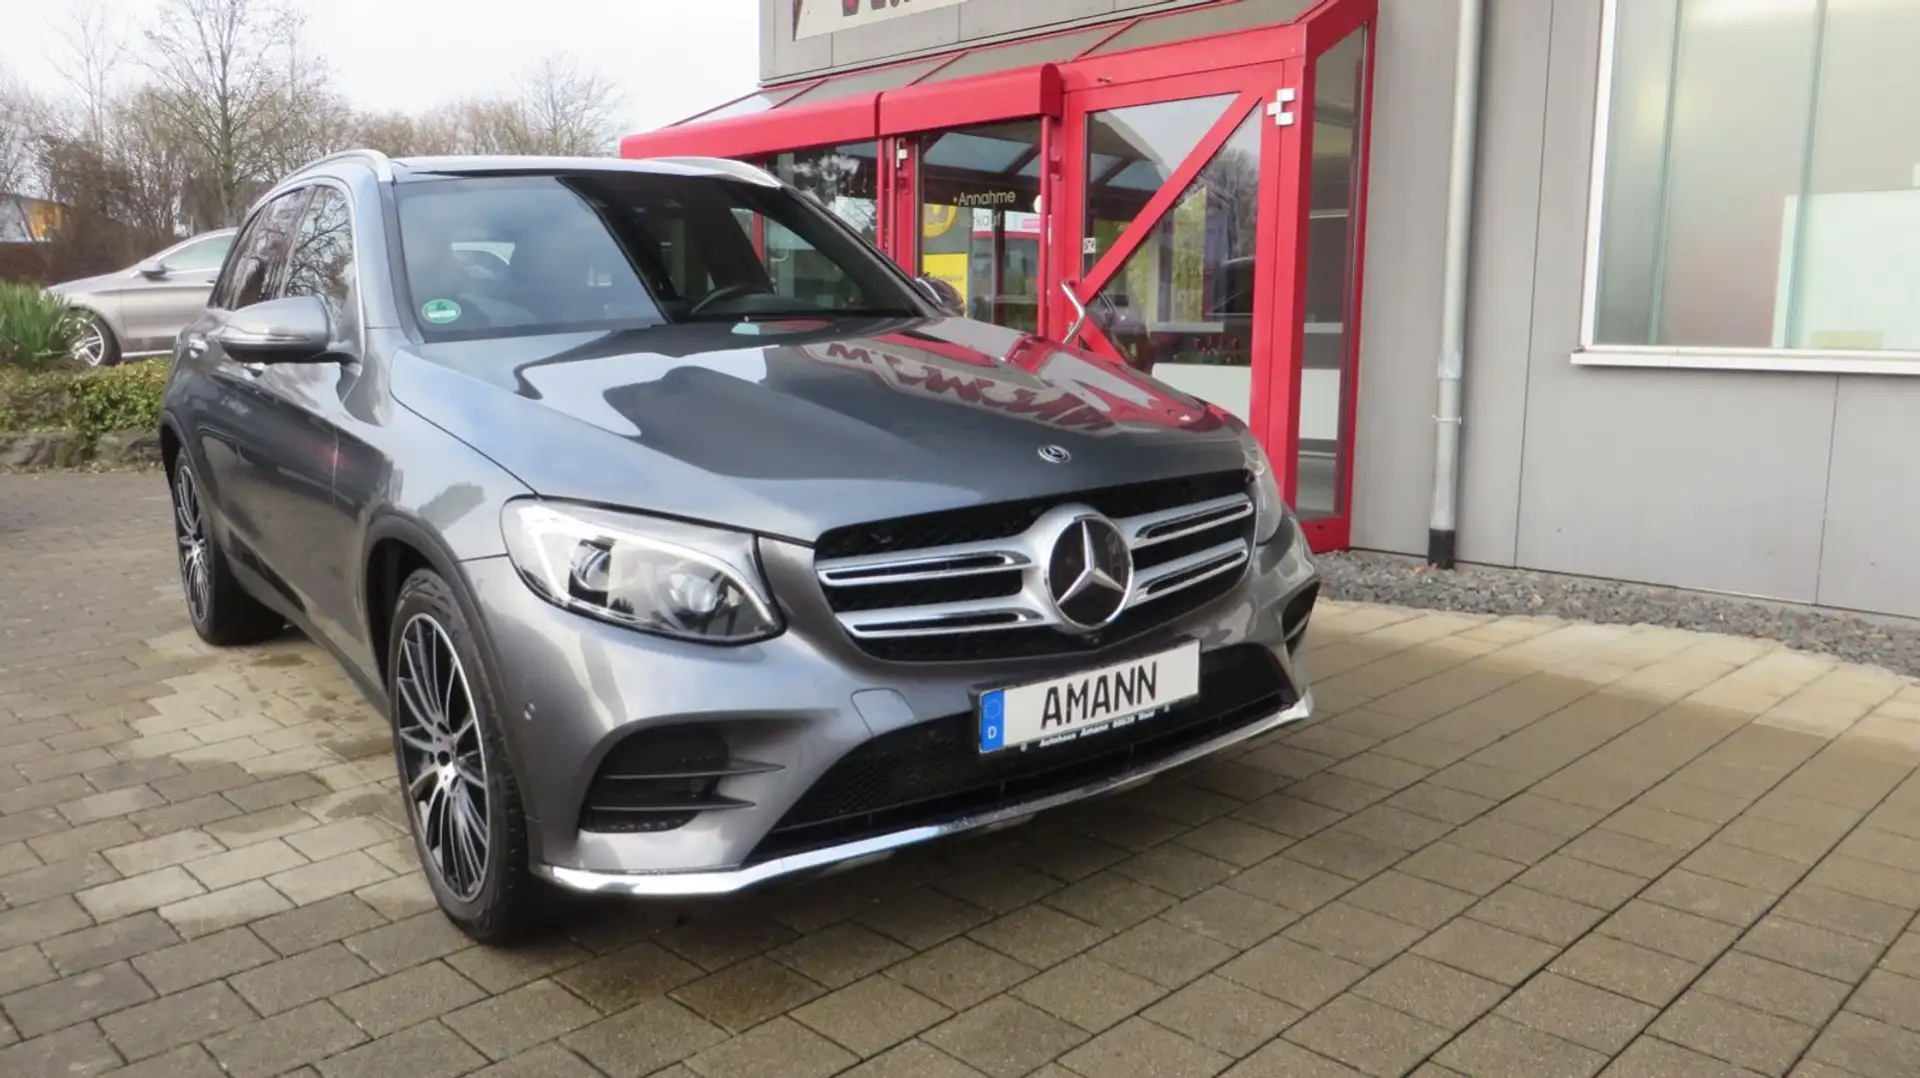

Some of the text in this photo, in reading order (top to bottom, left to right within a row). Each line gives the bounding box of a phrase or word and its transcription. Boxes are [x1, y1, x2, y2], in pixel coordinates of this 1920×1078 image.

[958, 190, 1016, 206] Annahme
[1040, 661, 1157, 730] AMANN
[987, 725, 998, 740] D
